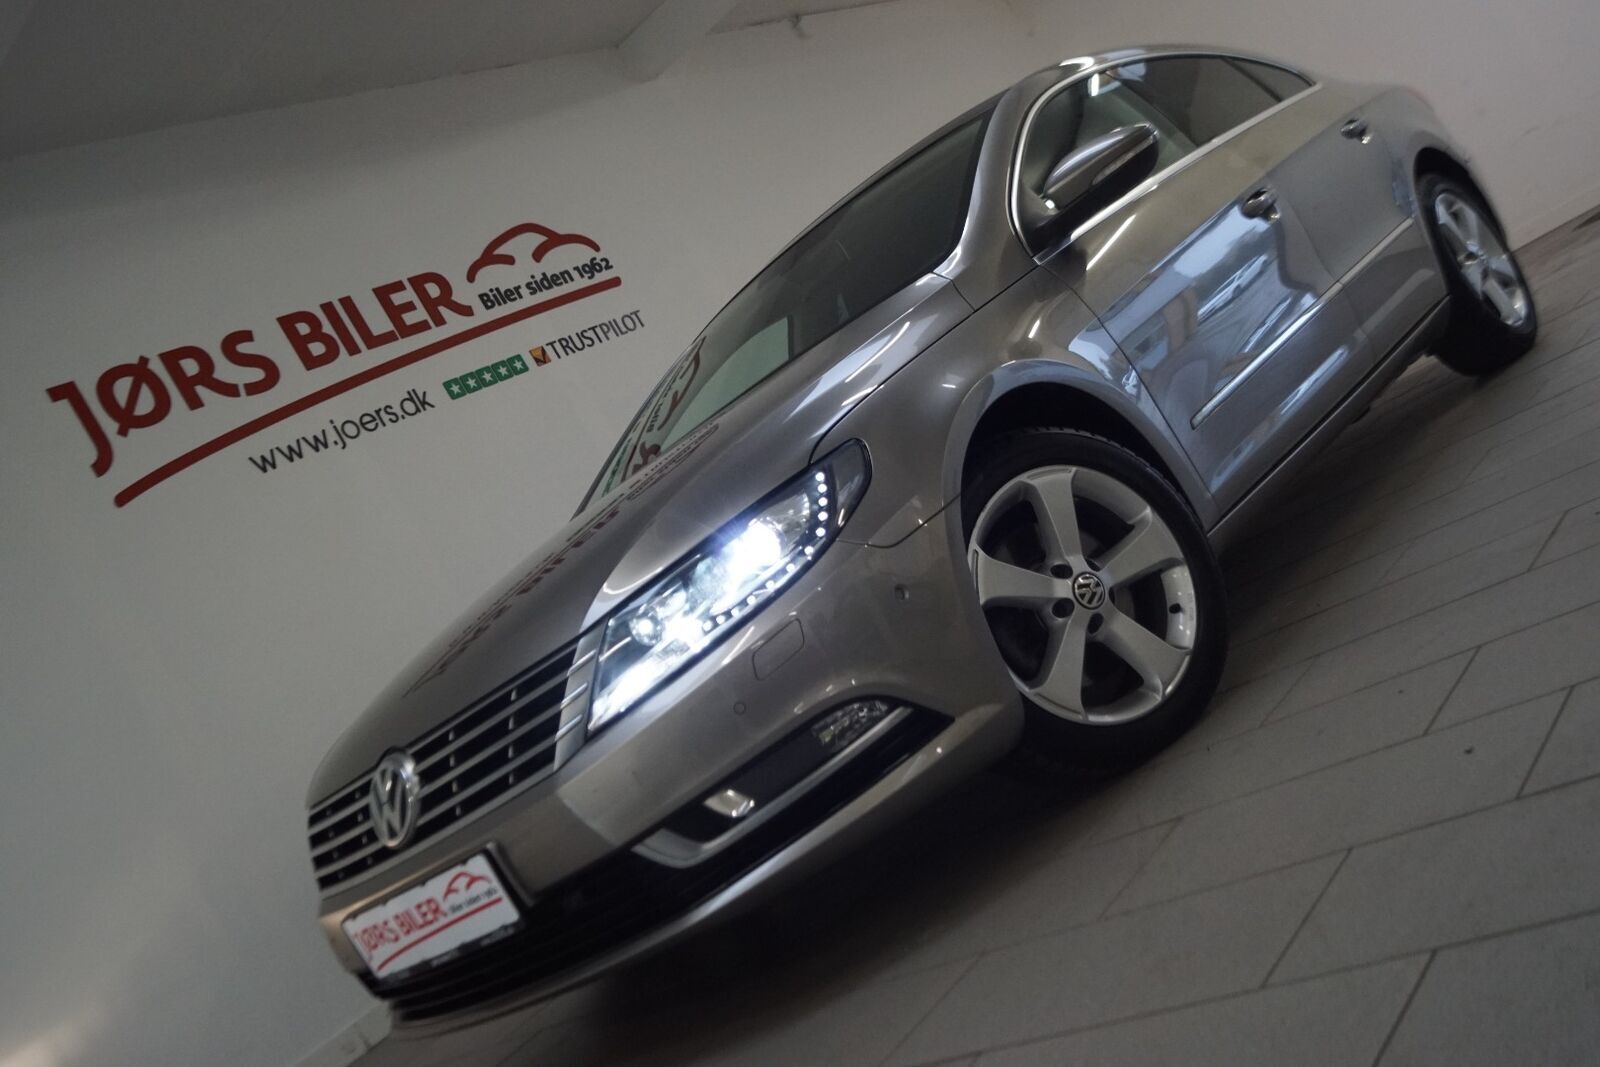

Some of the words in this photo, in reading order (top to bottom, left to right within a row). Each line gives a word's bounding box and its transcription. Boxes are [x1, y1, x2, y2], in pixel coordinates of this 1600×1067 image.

[478, 286, 526, 310] Biler
[525, 270, 575, 296] siden
[573, 256, 614, 280] 1962
[545, 310, 645, 359] TRUSTPILOT
[46, 329, 280, 477] JØRS
[276, 272, 474, 371] BILER
[248, 388, 436, 475] www.joers.dk
